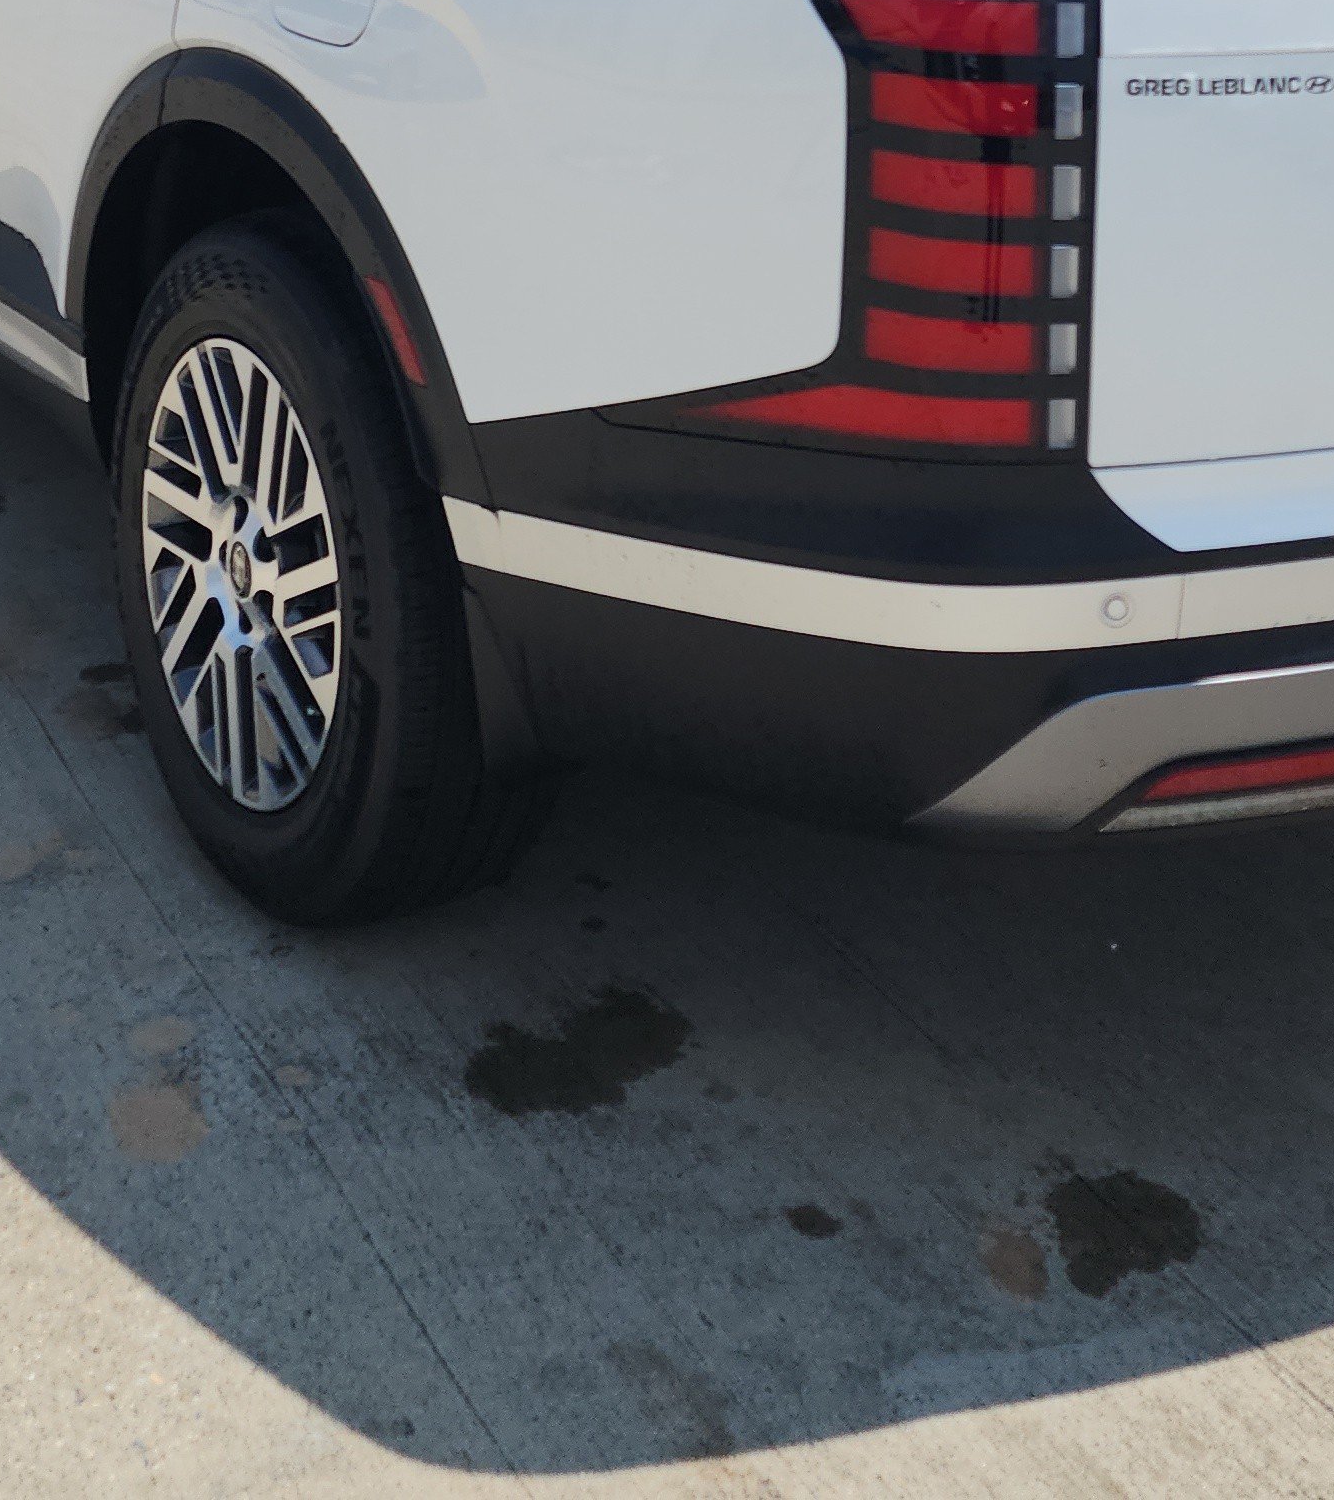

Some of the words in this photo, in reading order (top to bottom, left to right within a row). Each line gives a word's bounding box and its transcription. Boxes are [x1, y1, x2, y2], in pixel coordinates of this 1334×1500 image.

[1126, 77, 1191, 96] GREG
[1196, 76, 1302, 96] LEBLANC
[319, 418, 370, 640] NEXEN
